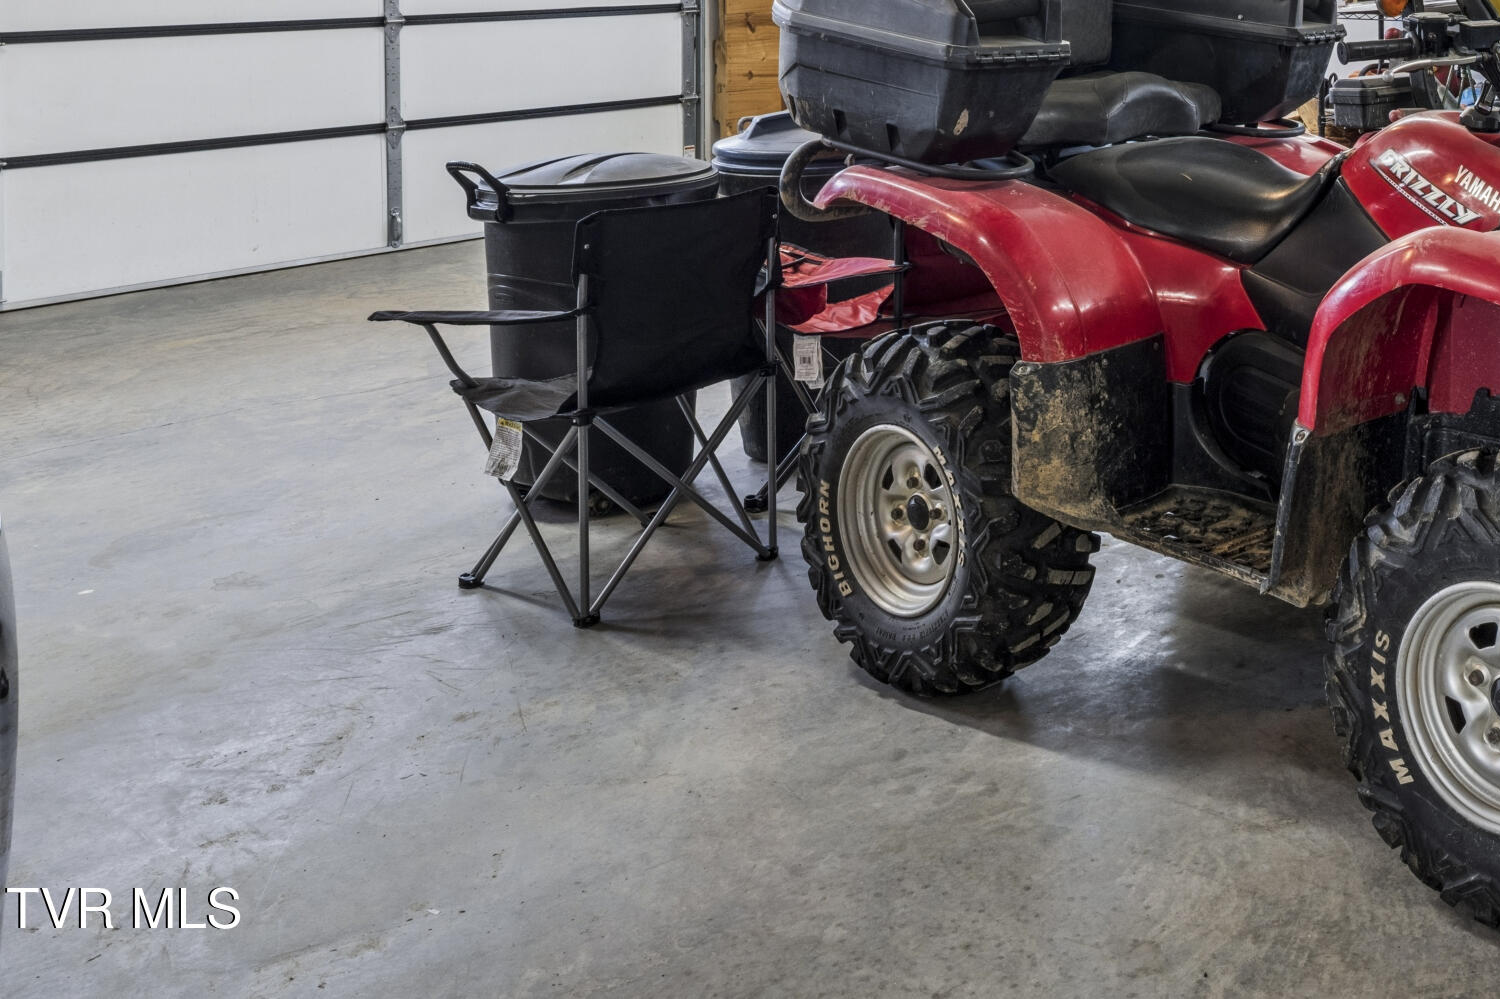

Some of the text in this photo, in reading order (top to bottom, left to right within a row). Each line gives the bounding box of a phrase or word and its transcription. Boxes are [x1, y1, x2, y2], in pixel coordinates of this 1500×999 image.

[1378, 148, 1484, 226] GRIZZLY
[818, 479, 853, 598] BIGHORN
[933, 445, 967, 567] MAXXIS
[1370, 629, 1415, 786] MAXXIS
